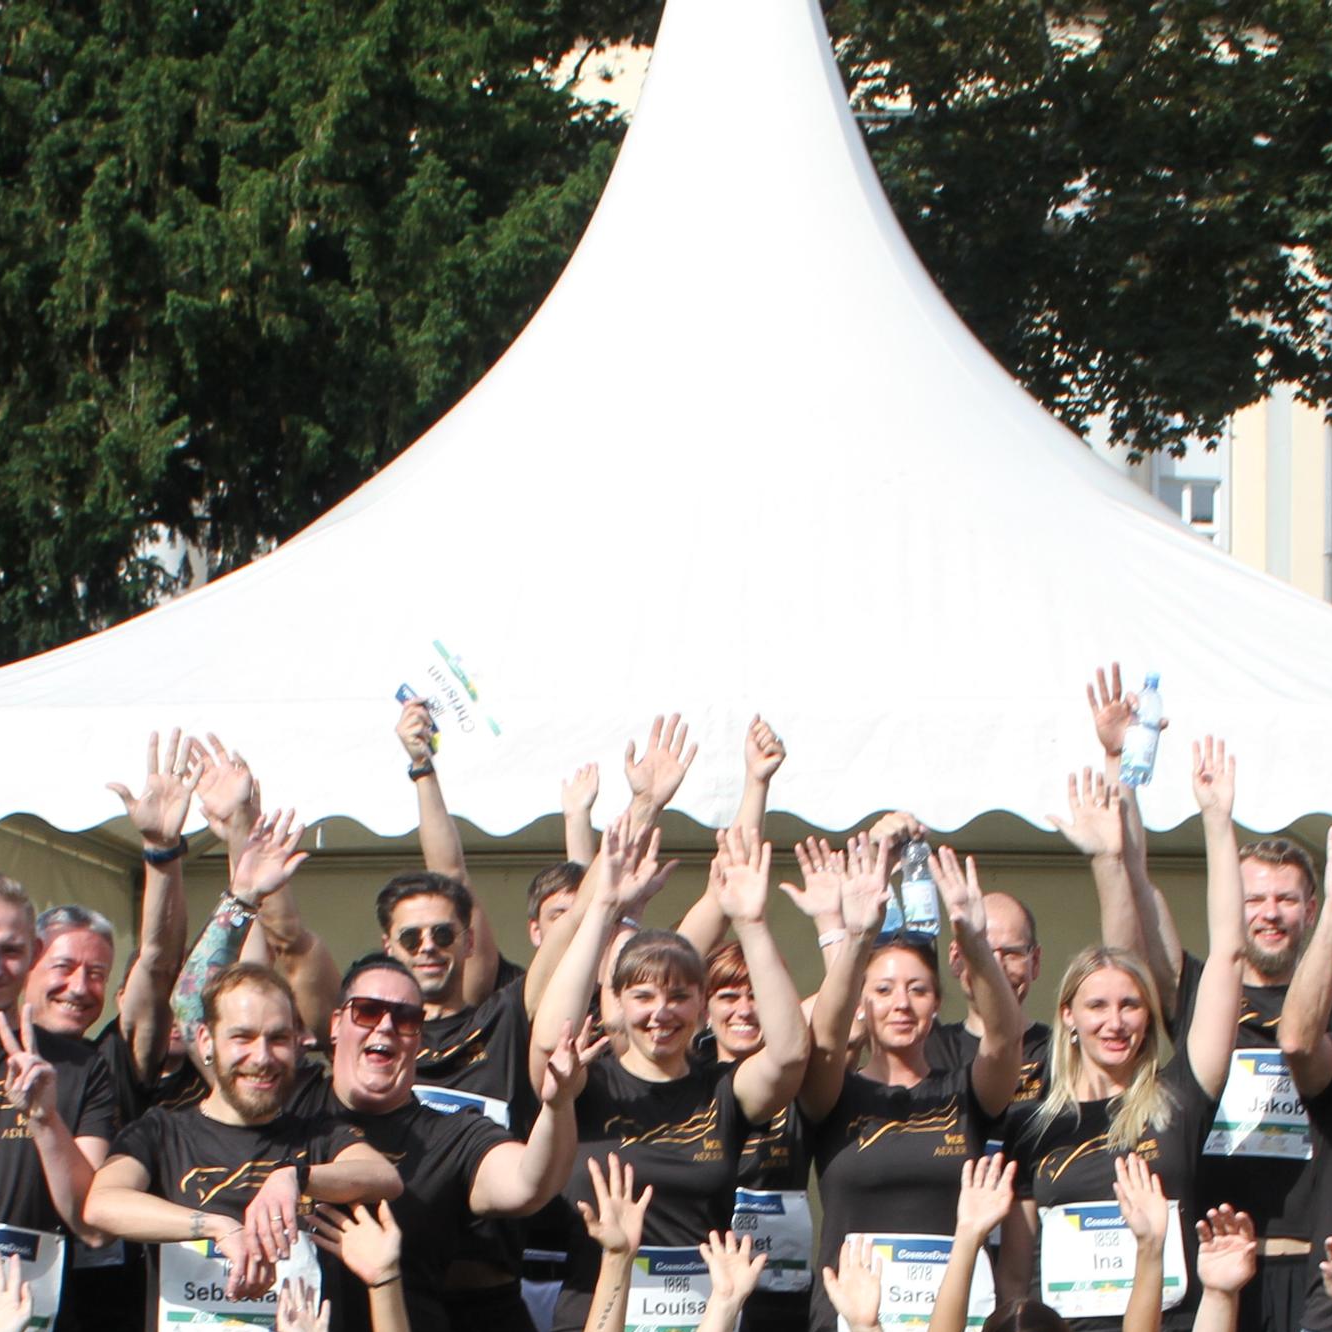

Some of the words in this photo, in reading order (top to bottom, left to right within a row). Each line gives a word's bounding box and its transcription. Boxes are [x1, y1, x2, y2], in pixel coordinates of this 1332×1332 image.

[427, 665, 475, 733] Christian
[1248, 1097, 1306, 1116] Jakob
[1093, 1253, 1124, 1270] Ina
[888, 1285, 937, 1304] Sara
[642, 1297, 707, 1316] Louisa
